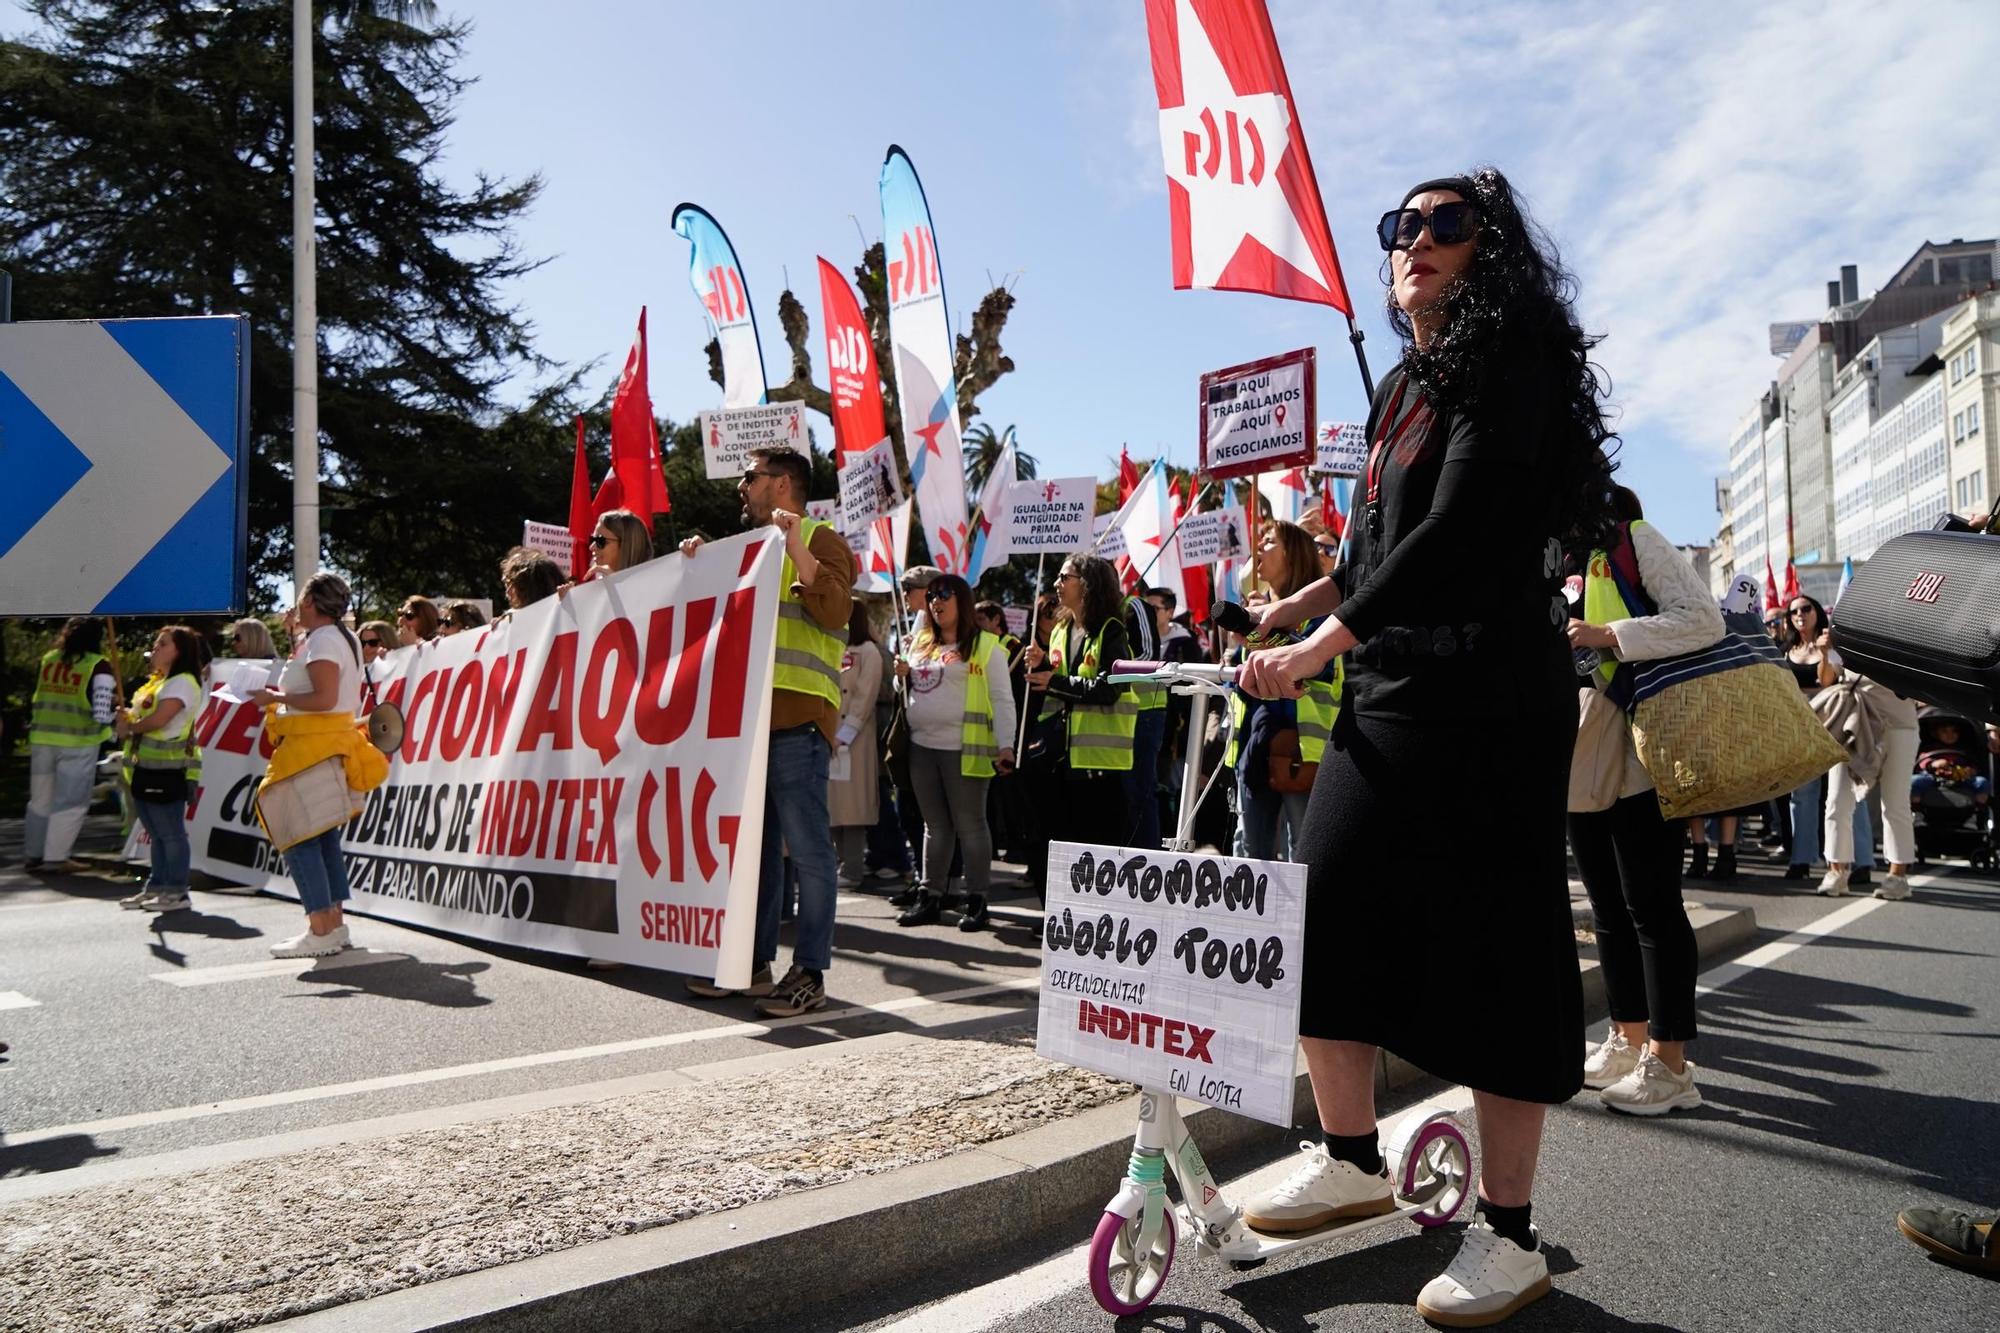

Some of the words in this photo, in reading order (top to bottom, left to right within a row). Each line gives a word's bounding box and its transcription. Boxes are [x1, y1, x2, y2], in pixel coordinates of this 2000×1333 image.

[1240, 373, 1270, 394] AQUÍ
[1213, 388, 1300, 419] TRABALLAMOS
[709, 414, 722, 422] AS
[724, 406, 799, 421] DEPENDENT@S
[727, 423, 739, 431] DE
[742, 419, 783, 429] INDITEX
[737, 430, 775, 440] NESTAS
[1216, 431, 1302, 460] NEGOCIAMOS!
[716, 453, 740, 462] NON
[1324, 462, 1362, 470] NEGOC
[848, 474, 874, 495] COMIDA
[845, 496, 863, 511] CADA
[863, 488, 876, 501] DÍA
[1013, 502, 1067, 514] IGUALDADE
[1069, 502, 1084, 512] NA
[847, 511, 860, 524] TRA
[1185, 516, 1217, 529] ROSALÍA
[1031, 524, 1061, 534] PRIMA
[1188, 527, 1218, 539] COMIDA
[530, 536, 539, 544] DE
[1011, 532, 1079, 545] VINCULACIÓN
[1183, 539, 1203, 550] CADA
[1204, 537, 1218, 546] DÍA
[1184, 550, 1198, 559] TRA
[1906, 572, 1945, 603] JBL
[516, 540, 766, 766] AQUÍ
[445, 783, 483, 853] DE
[476, 777, 625, 864] INDITEX
[377, 861, 418, 900] PARA
[422, 864, 440, 902] O
[440, 867, 535, 922] MUNDO
[1070, 851, 1268, 916] MOTOMAMI
[1046, 907, 1157, 966] WORLD
[1174, 927, 1285, 989] TOUR
[1050, 968, 1146, 1005] DEPENDENTAS
[1078, 1000, 1216, 1064] INDITEX
[1169, 1069, 1190, 1093] EN
